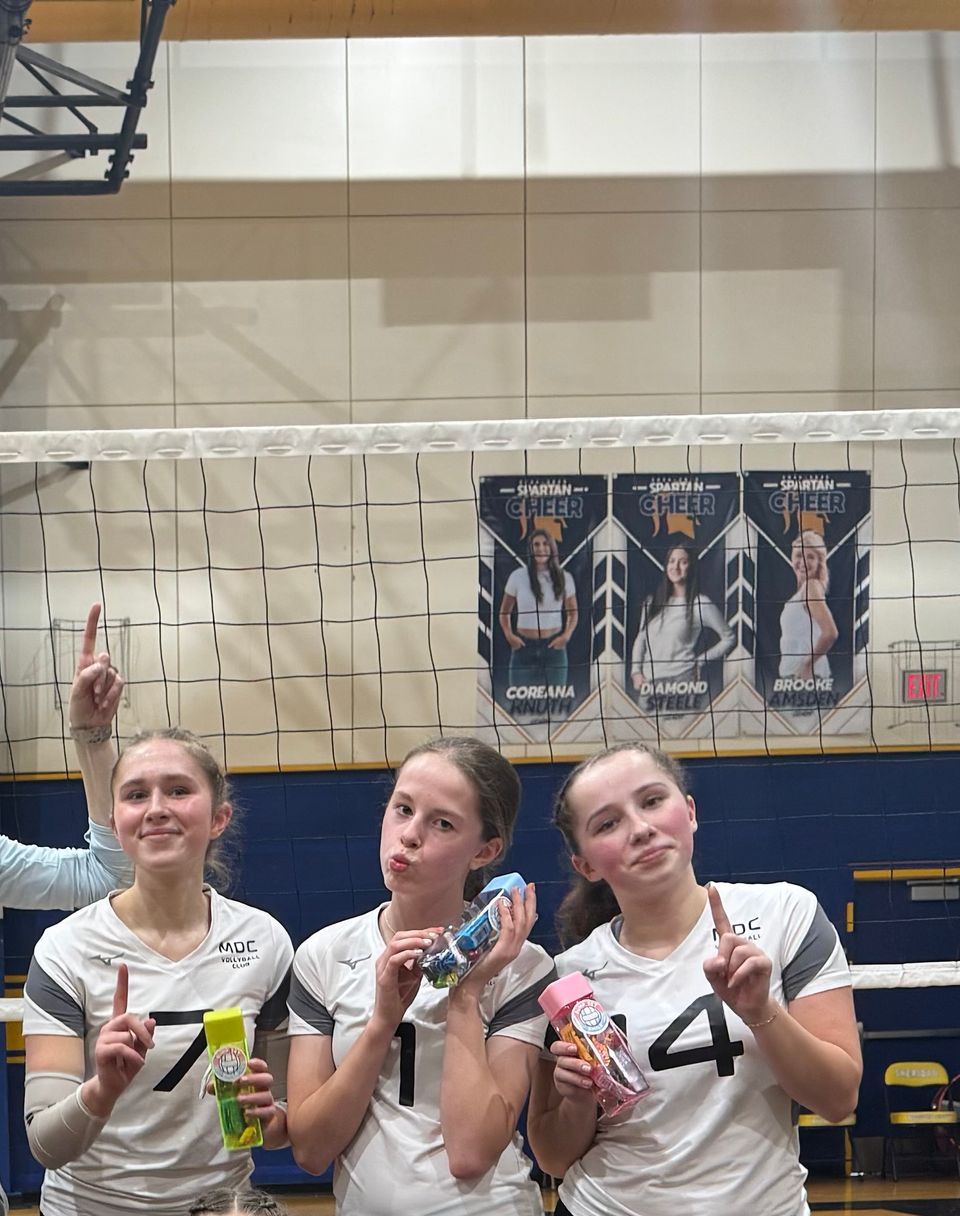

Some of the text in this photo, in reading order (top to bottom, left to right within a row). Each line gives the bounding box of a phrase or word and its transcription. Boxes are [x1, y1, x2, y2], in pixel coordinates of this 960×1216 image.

[516, 484, 573, 497] SPARTAN
[649, 481, 704, 495] SPARTAN
[780, 480, 835, 492] SPARTAN
[505, 496, 584, 520] CHEER
[639, 492, 716, 517] CHEER
[768, 490, 846, 514] CHEER
[506, 685, 575, 699] COREANA
[640, 680, 708, 696] DIAMOND
[773, 677, 834, 692] BROOKE
[906, 672, 942, 699] EXIT
[510, 699, 572, 715] KNUTH
[645, 695, 703, 711] STEELE
[770, 691, 839, 707] AMSDEN
[218, 940, 258, 954] MDC
[221, 954, 261, 963] VOLLYBALL
[149, 1009, 214, 1092] 7
[395, 1022, 417, 1107] 1
